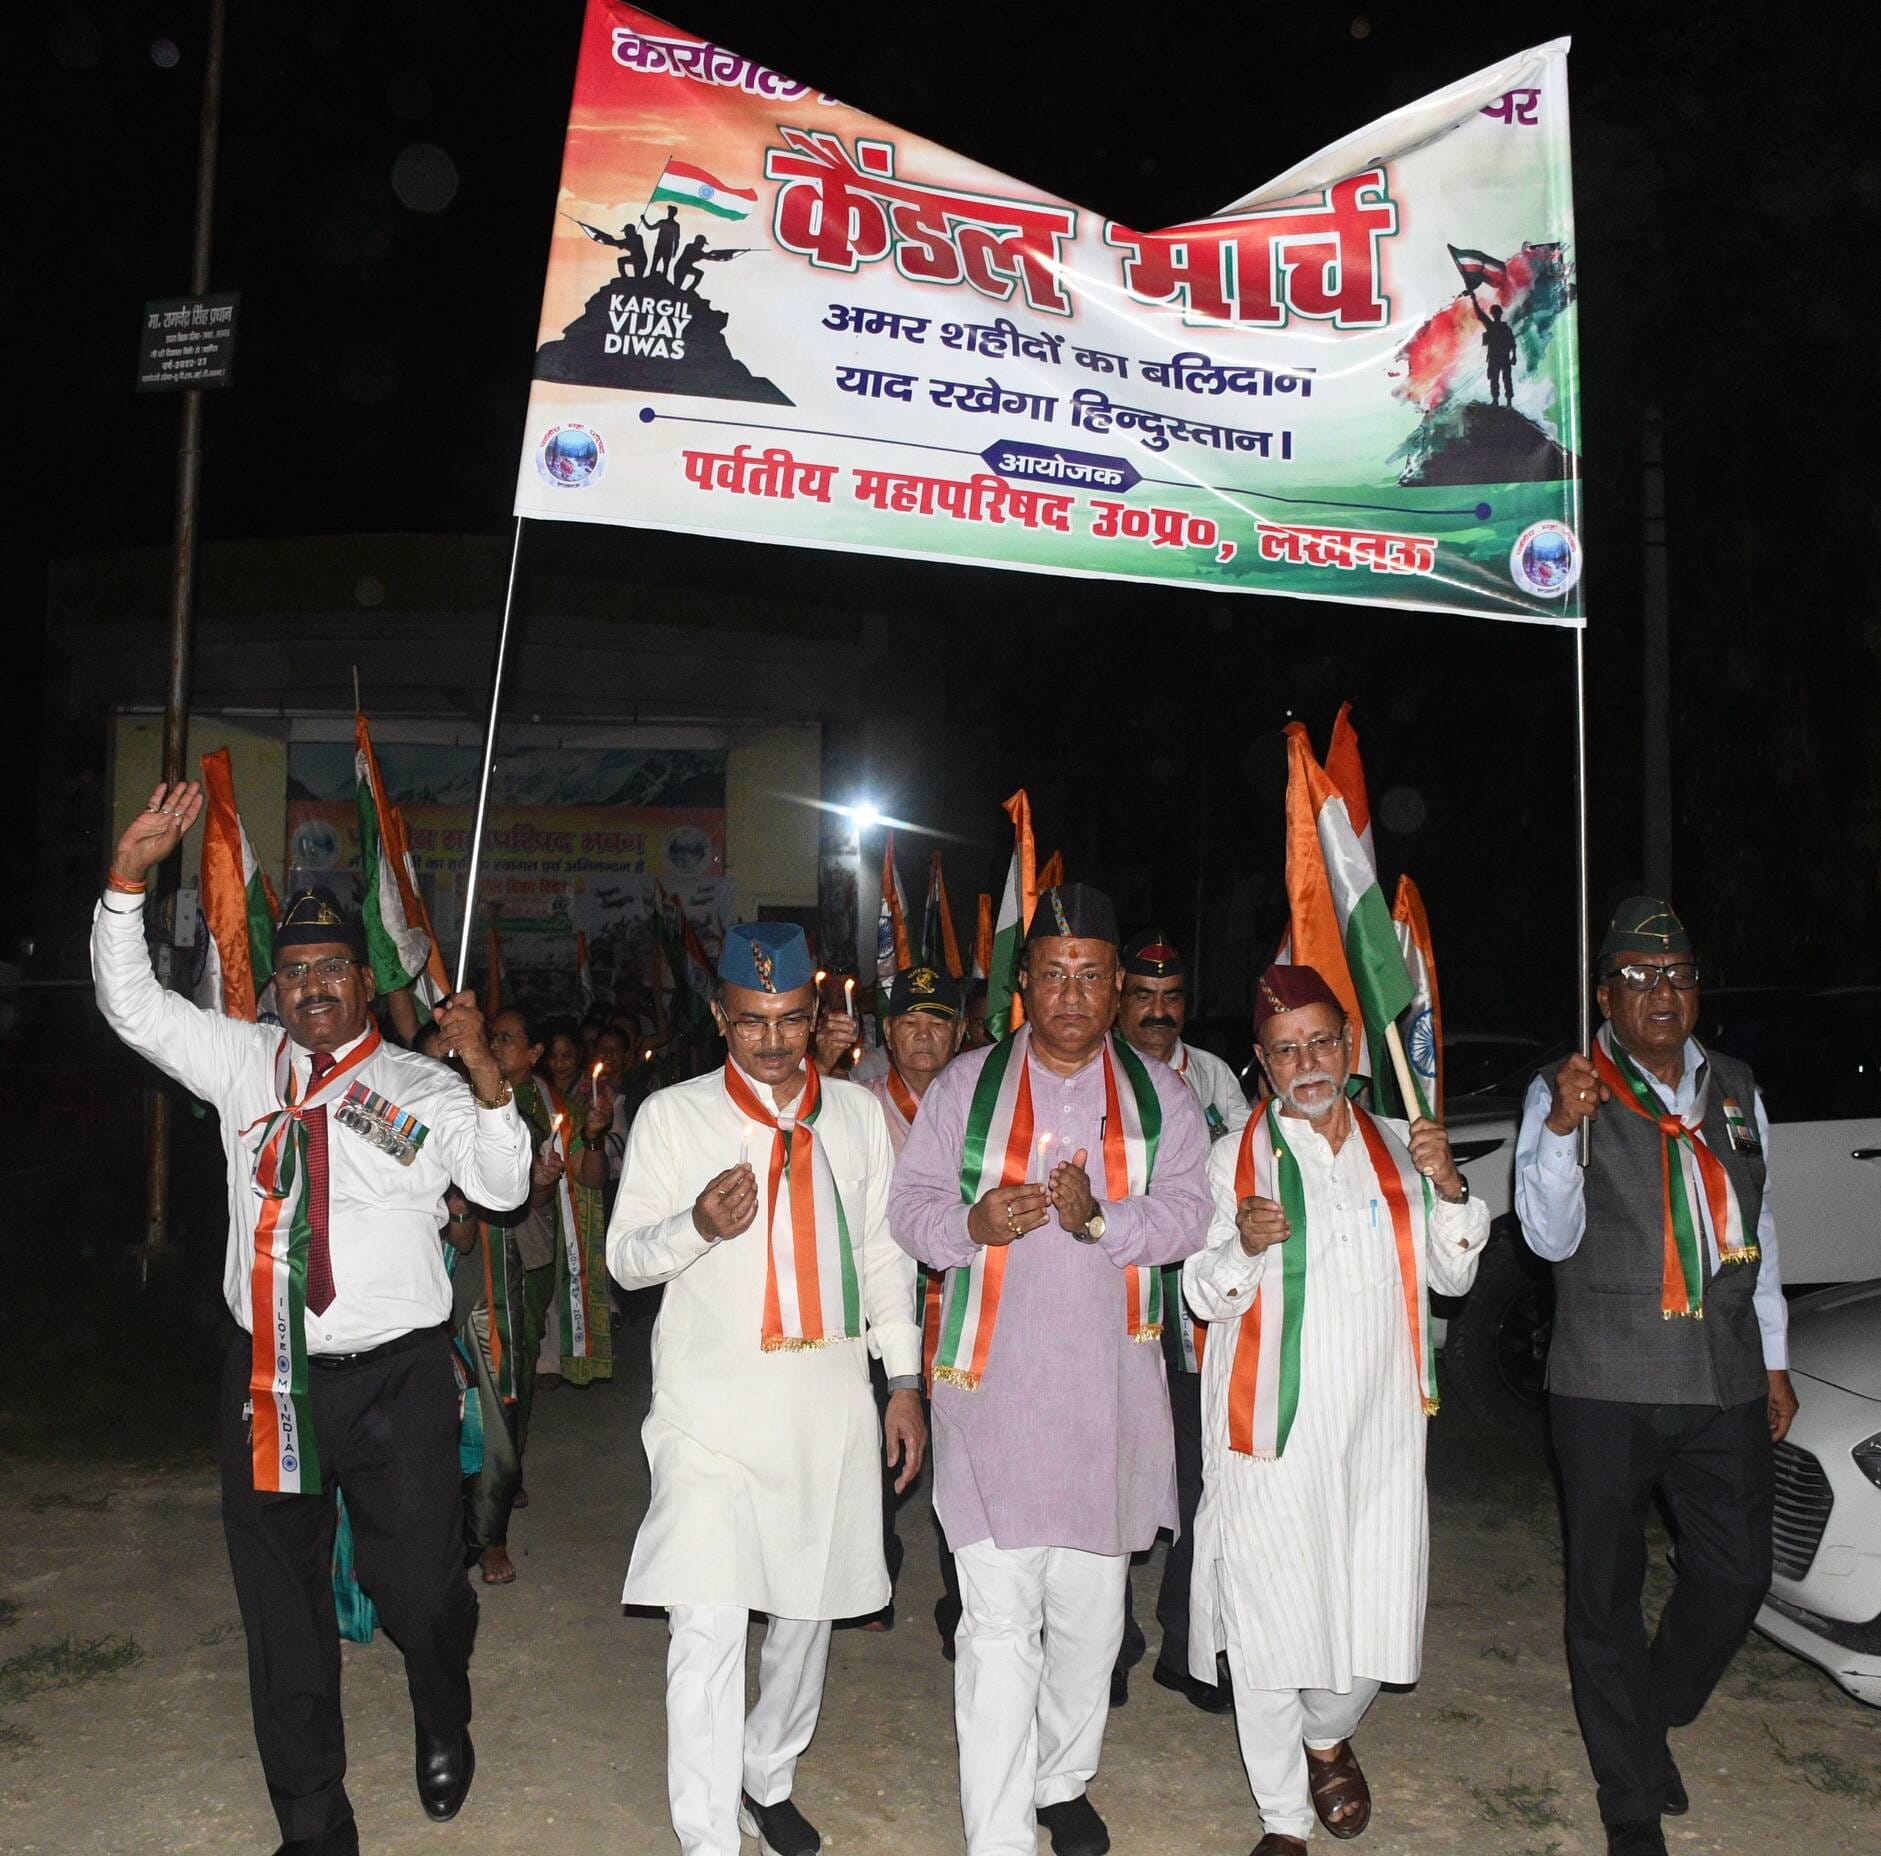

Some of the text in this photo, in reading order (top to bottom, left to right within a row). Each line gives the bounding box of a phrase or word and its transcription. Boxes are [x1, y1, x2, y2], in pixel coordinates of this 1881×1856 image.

[765, 125, 1398, 329] कैंडल मार्च
[608, 311, 690, 339] VIJAY
[610, 294, 693, 319] KARGIL
[604, 333, 685, 360] DIWAS
[822, 304, 1317, 397] अमर शहीदों का बलिदान
[835, 365, 919, 402] याद
[929, 377, 1059, 422] रखेगा
[998, 453, 1124, 486] आयोजक
[682, 444, 839, 503] पर्वतीय
[852, 468, 1075, 532] महापरिषद
[1256, 523, 1435, 573] लखनऊ
[278, 1311, 287, 1351] LOVE
[278, 1378, 288, 1399] MY
[281, 1403, 295, 1453] INDIA
